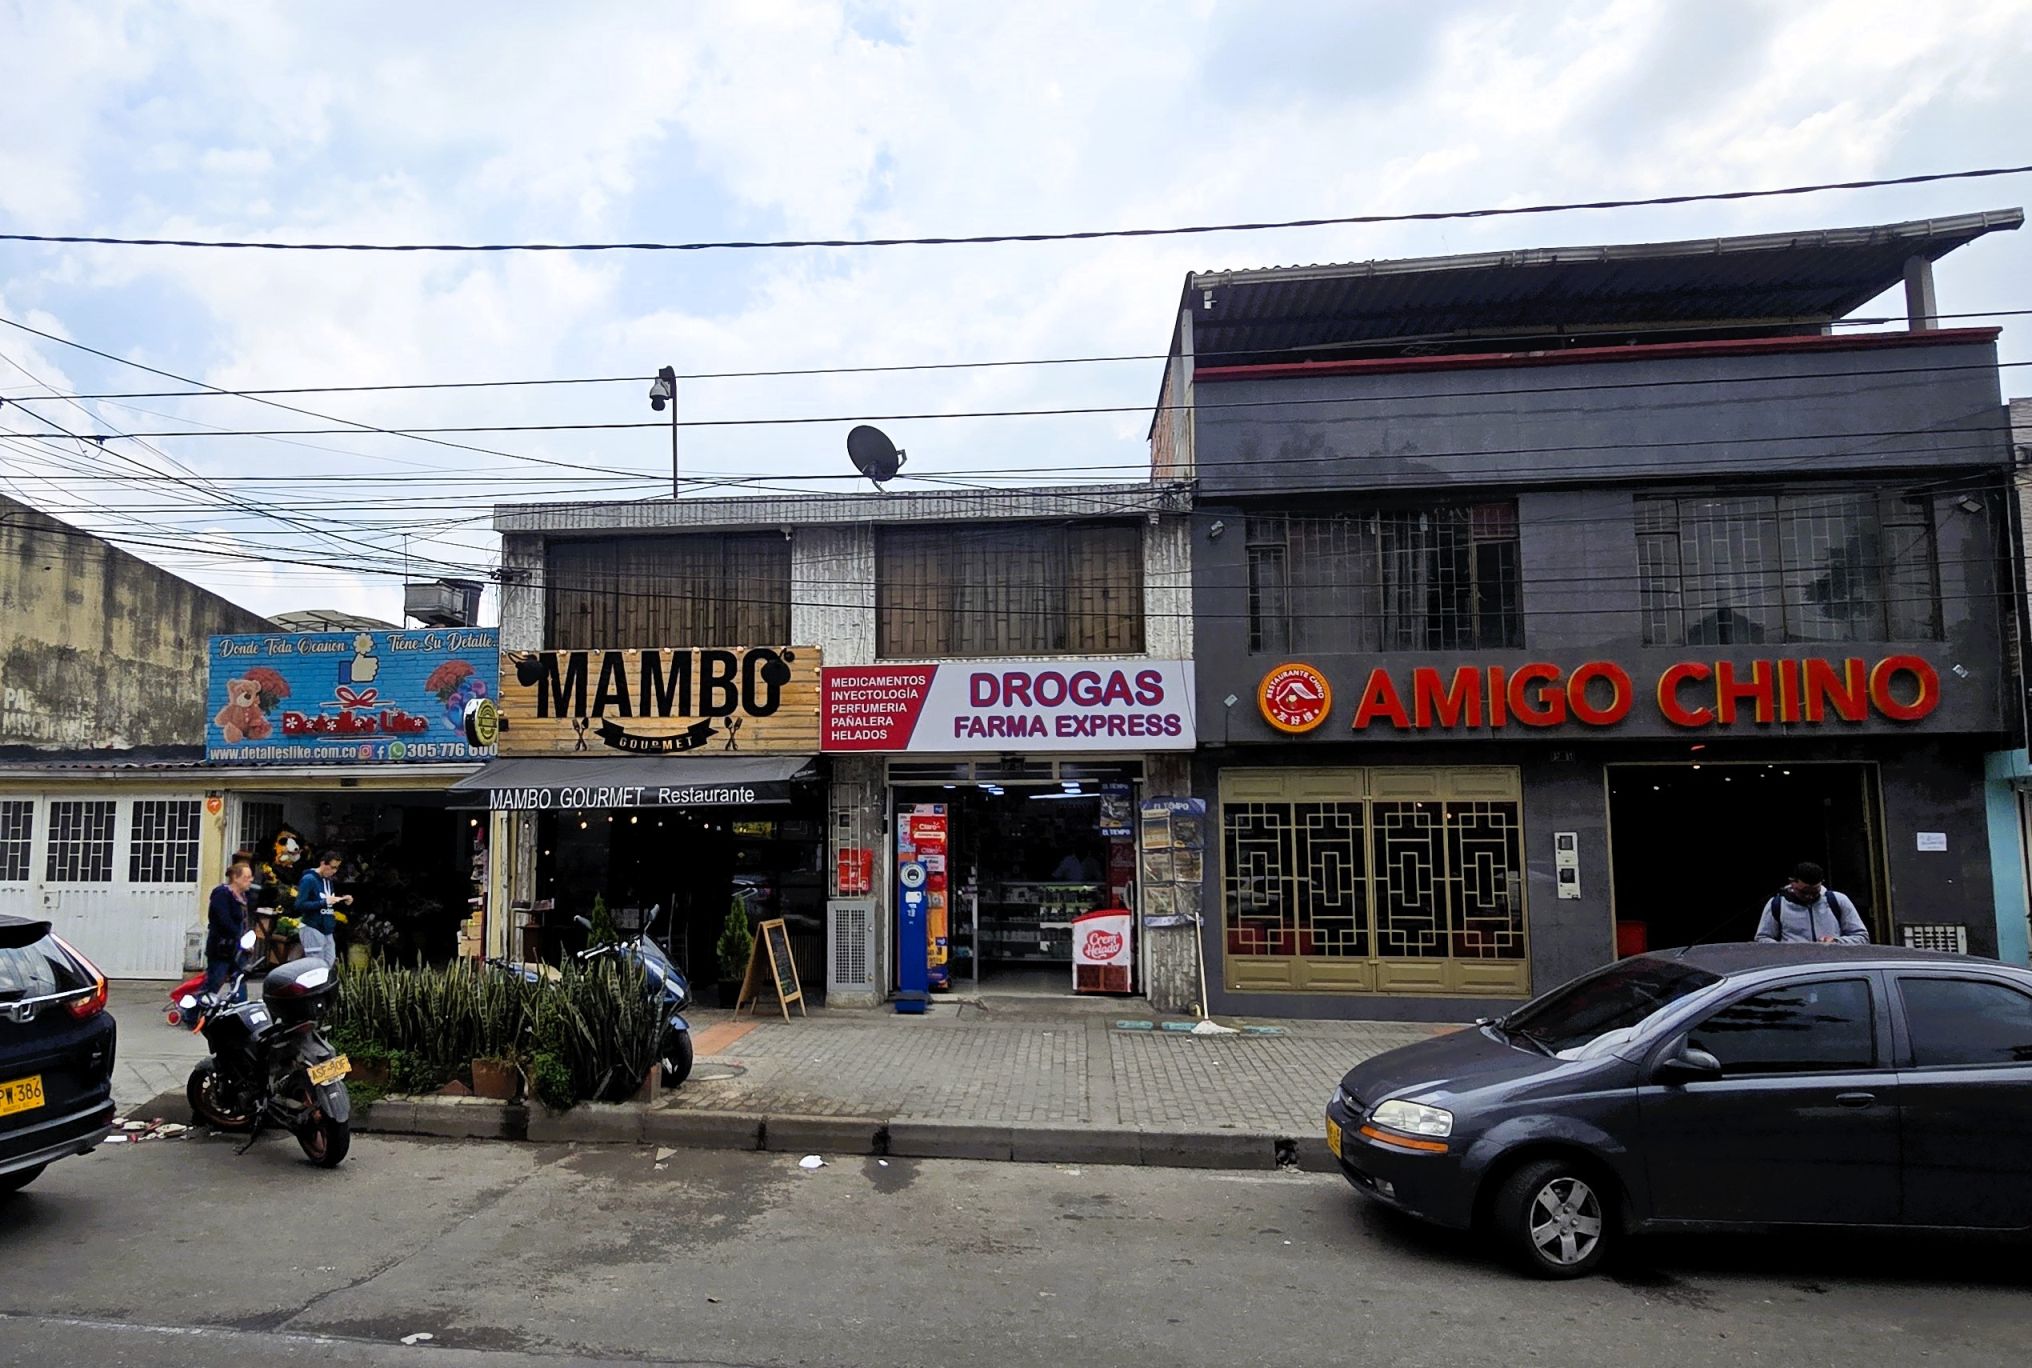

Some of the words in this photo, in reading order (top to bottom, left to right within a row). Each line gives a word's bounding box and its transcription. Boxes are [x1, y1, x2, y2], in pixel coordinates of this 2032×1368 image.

[220, 638, 259, 657] Donde
[264, 638, 293, 655] Toda
[387, 634, 419, 652] Tiene
[424, 633, 441, 652] Su
[537, 648, 781, 718] MAMBO
[831, 676, 926, 688] MEDICAMENTOS
[970, 669, 1165, 708] DROGAS
[1309, 675, 1325, 699] CHINO
[831, 687, 919, 701] INYECTOLOGÍA
[1352, 660, 1633, 729] AMIGO
[1657, 655, 1940, 727] CHINO
[831, 703, 907, 714] PERFUMERIA
[831, 715, 894, 727] PAÑALERA
[954, 715, 1048, 738] FARMA
[1055, 713, 1182, 738] EXPRESS
[619, 736, 693, 750] GOURMET
[831, 729, 888, 741] HELADOS
[210, 745, 356, 760] www.detalleslike.com.co
[407, 743, 437, 757] 305
[440, 743, 465, 757] 776
[489, 788, 551, 809] MAMBO
[560, 786, 645, 808] GOURMET
[659, 786, 755, 804] Restaurante
[1089, 932, 1118, 945] Crem
[1085, 943, 1120, 958] Helado
[16, 1080, 41, 1102] 386
